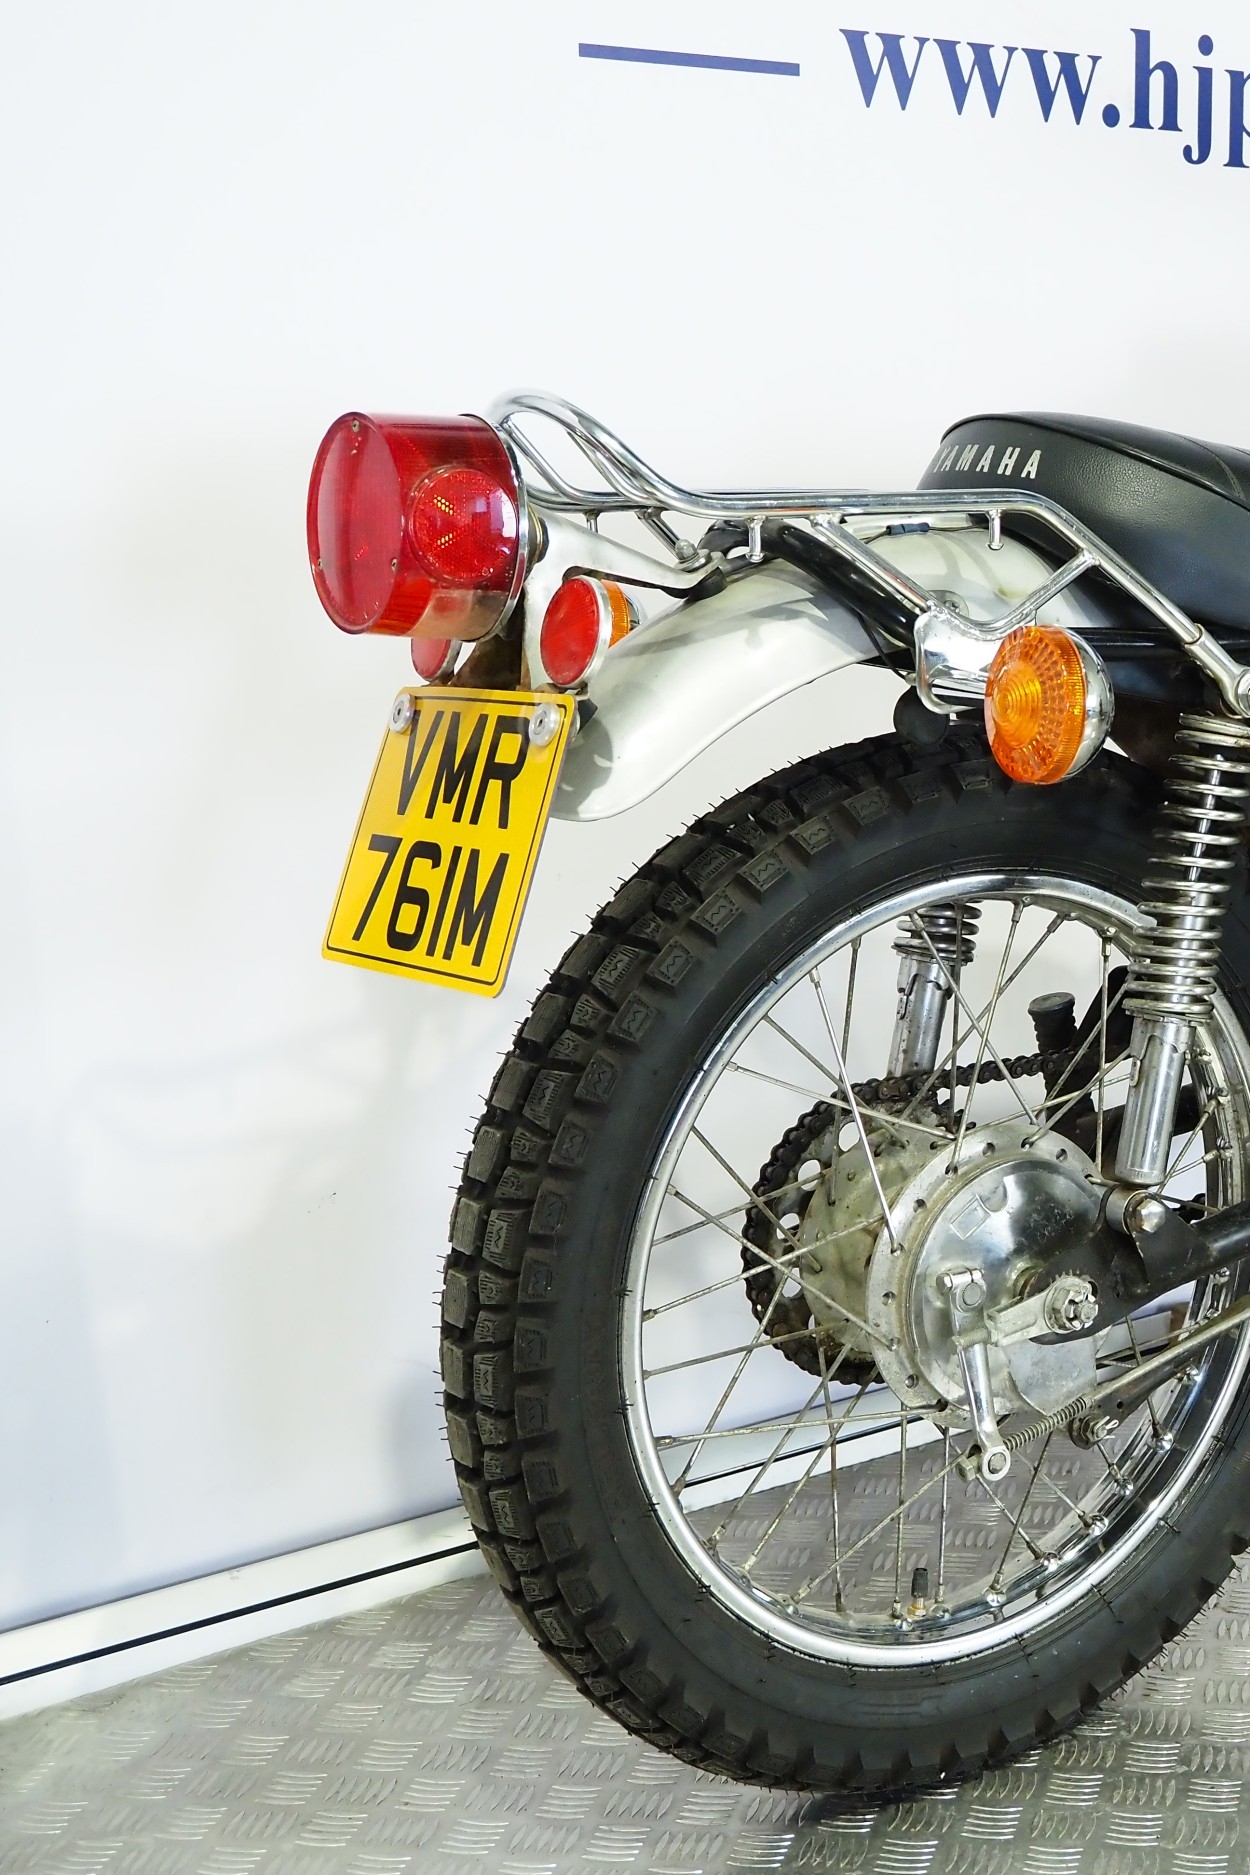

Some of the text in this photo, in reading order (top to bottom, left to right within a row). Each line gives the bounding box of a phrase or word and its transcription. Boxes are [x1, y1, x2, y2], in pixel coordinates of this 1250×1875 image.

[933, 444, 1041, 479] YAMAHA
[396, 710, 530, 829] VMR
[352, 835, 510, 967] 761M
